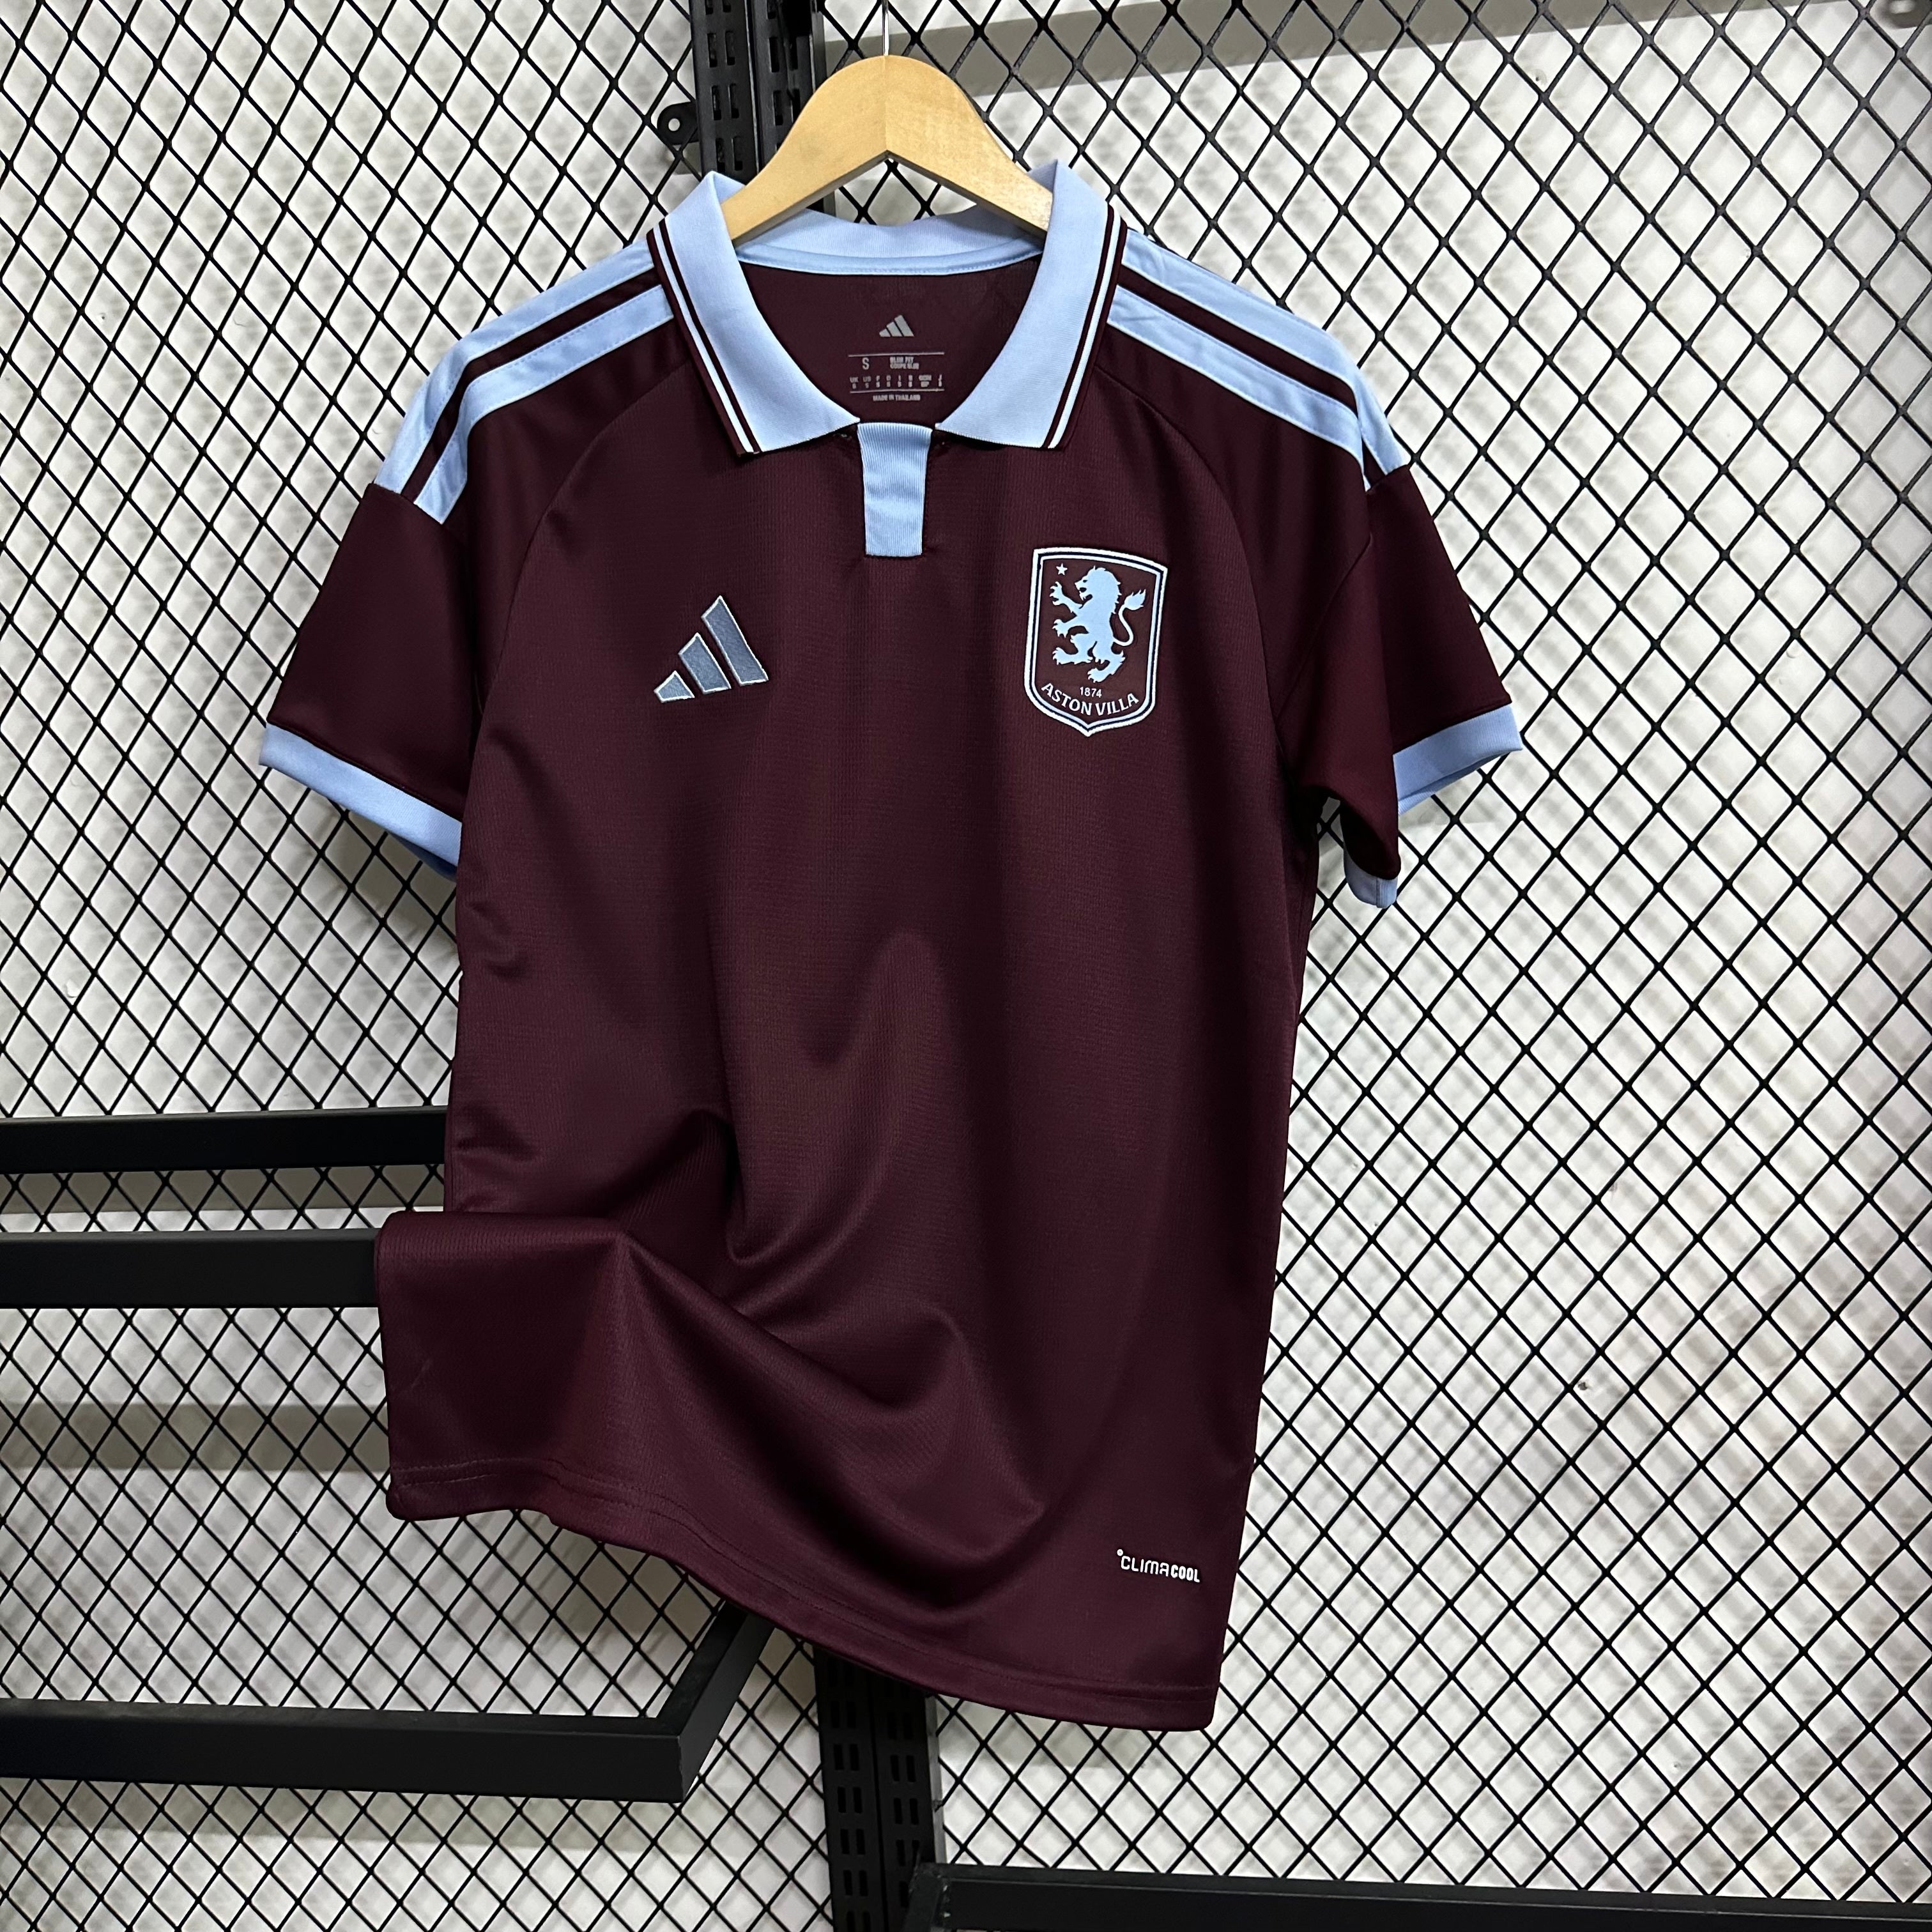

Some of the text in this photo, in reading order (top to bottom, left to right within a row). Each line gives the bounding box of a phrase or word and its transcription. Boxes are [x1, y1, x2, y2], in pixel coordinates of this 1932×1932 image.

[862, 357, 870, 370] S
[1080, 687, 1102, 698] 1874
[1041, 683, 1138, 716] ASTON VILLA
